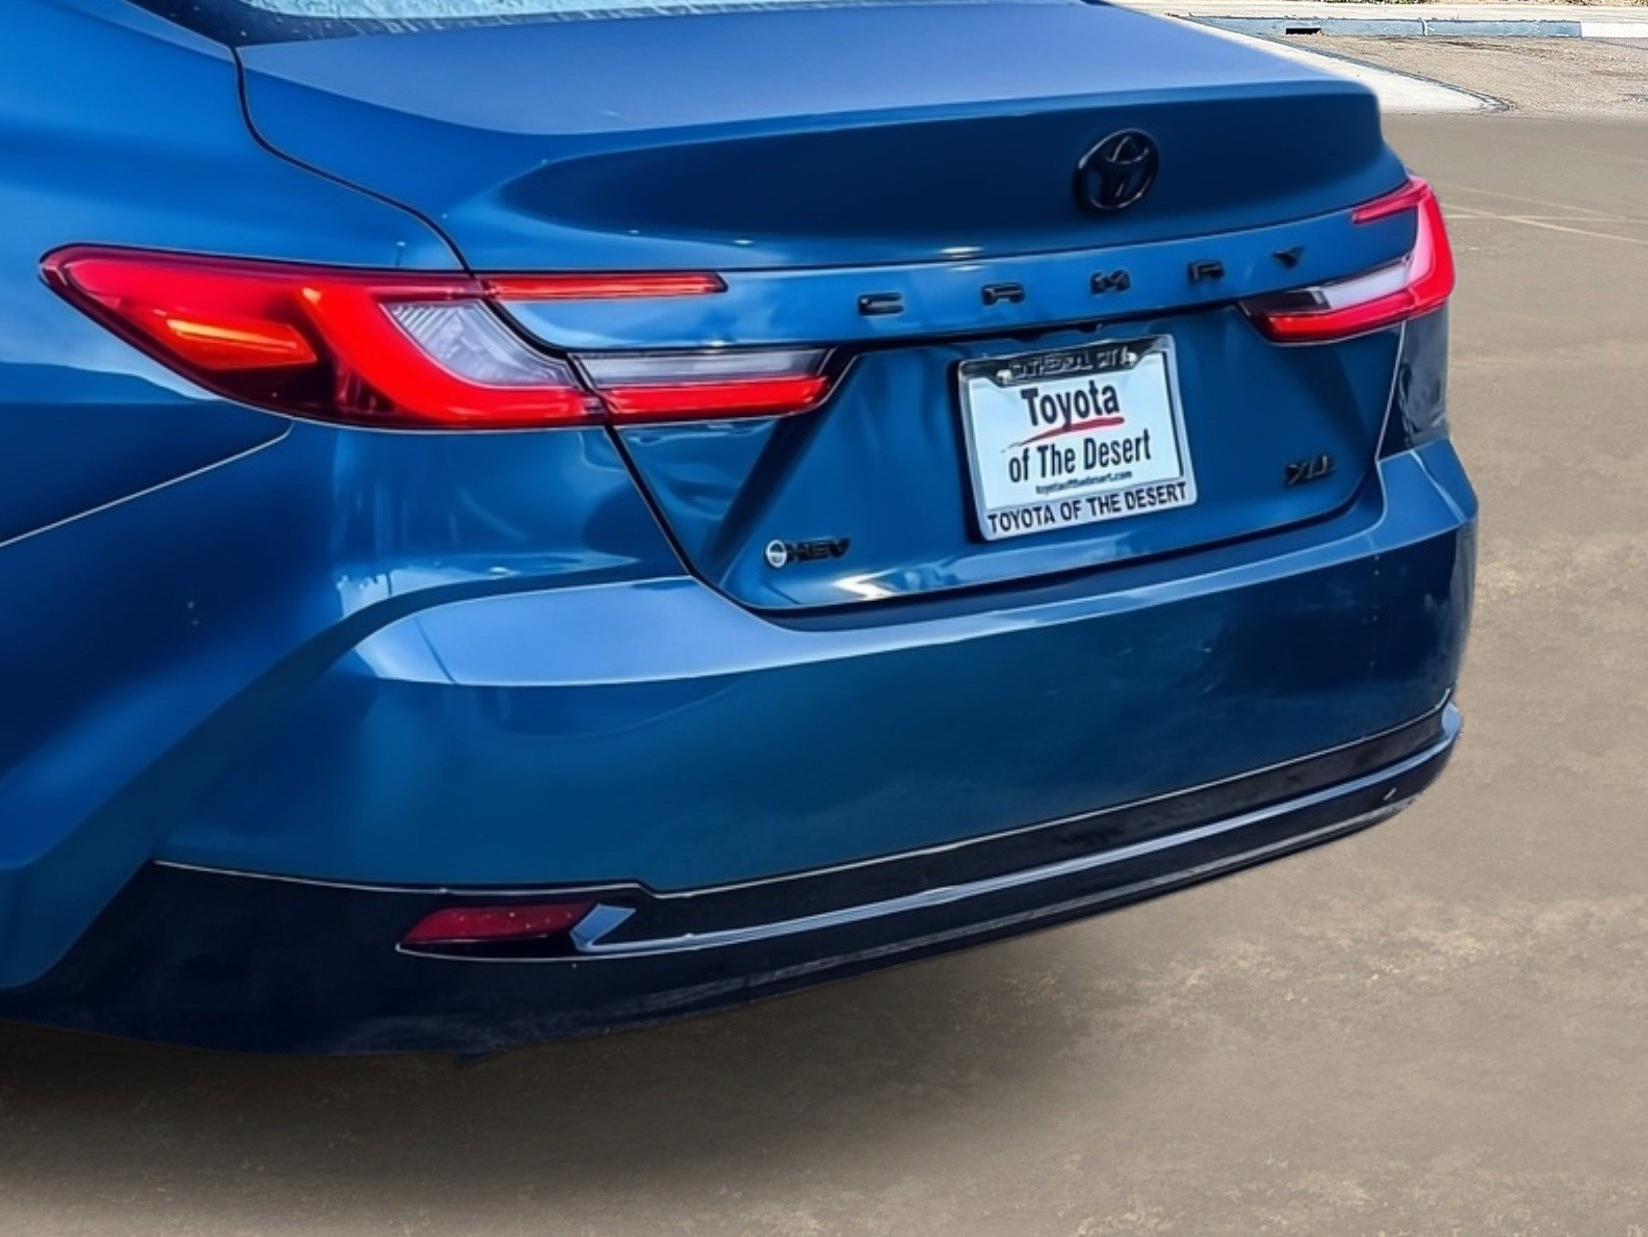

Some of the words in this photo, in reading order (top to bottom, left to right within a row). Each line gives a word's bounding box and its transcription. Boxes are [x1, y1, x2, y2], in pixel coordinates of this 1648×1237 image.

[1020, 380, 1120, 432] Toyota
[1008, 446, 1031, 483] of
[1037, 443, 1076, 479] The
[1083, 428, 1152, 471] Desert
[987, 505, 1056, 534] TOYOTA
[1060, 499, 1082, 520] OF
[1087, 491, 1122, 516] THE
[1124, 481, 1188, 509] DESERT
